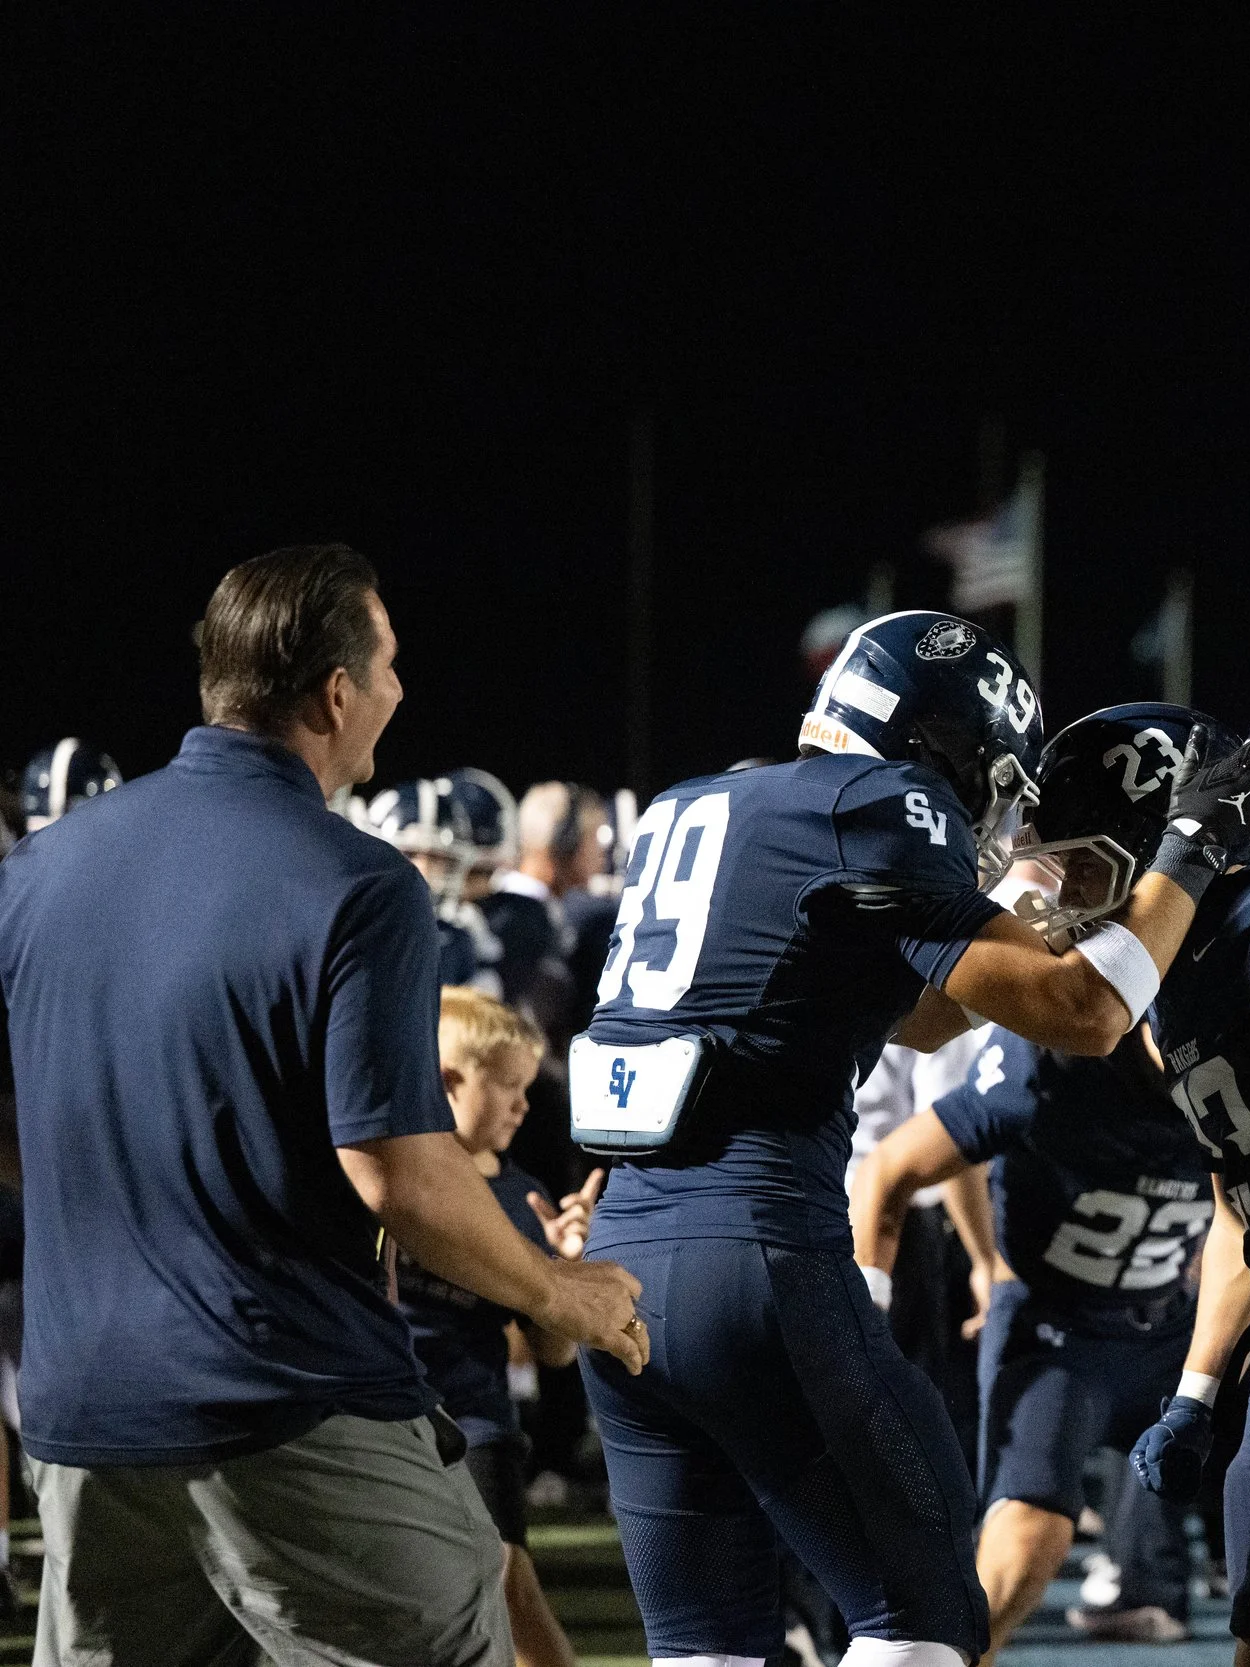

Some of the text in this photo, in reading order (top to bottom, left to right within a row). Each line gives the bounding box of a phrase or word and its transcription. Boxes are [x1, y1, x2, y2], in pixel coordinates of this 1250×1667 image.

[977, 652, 1036, 734] 39
[1103, 727, 1184, 803] 23
[905, 791, 948, 846] SV
[596, 791, 730, 1012] 39
[609, 1057, 636, 1109] SV
